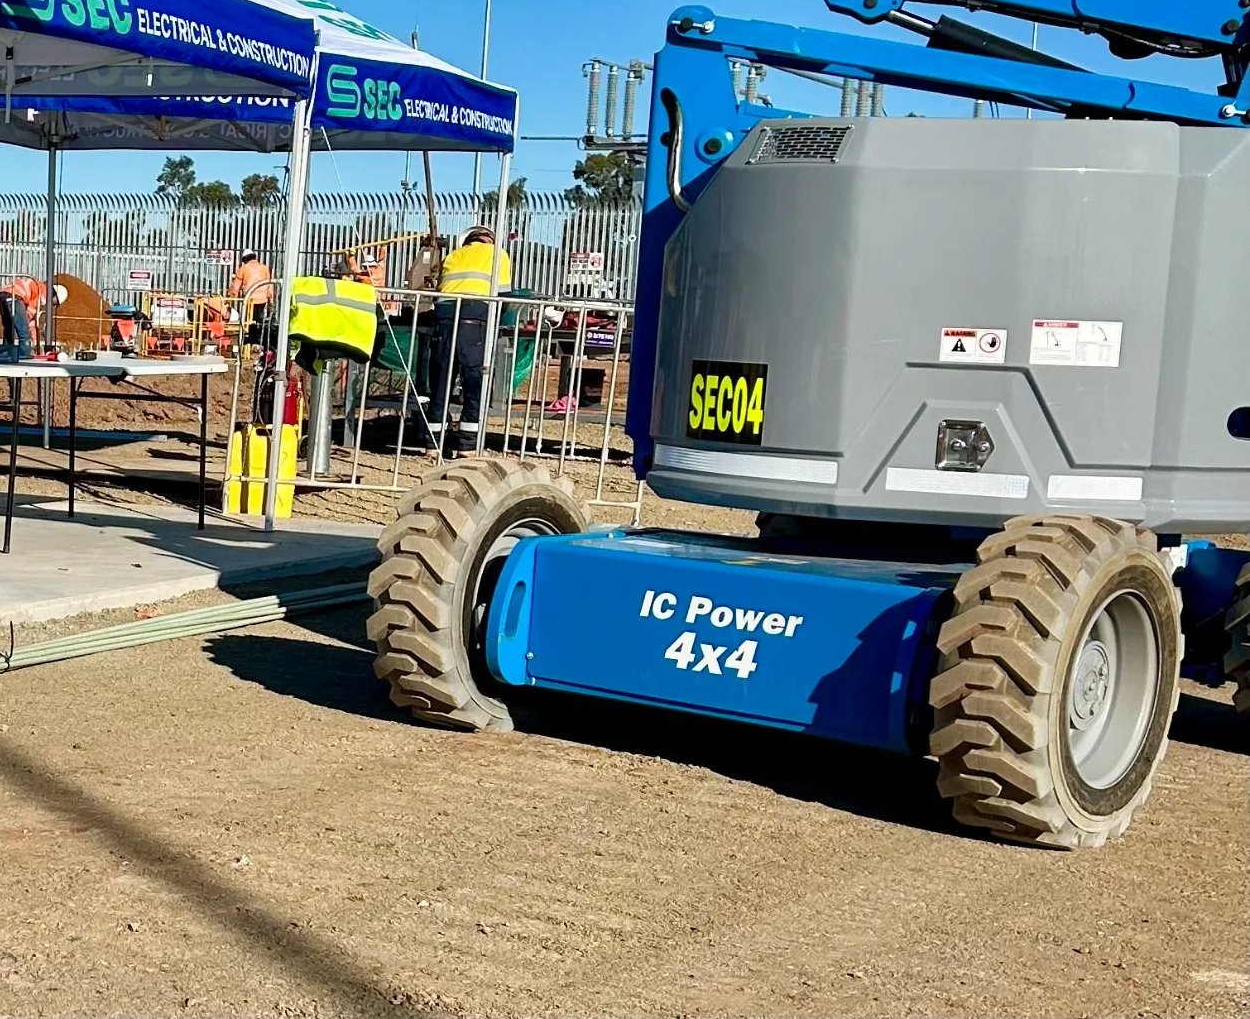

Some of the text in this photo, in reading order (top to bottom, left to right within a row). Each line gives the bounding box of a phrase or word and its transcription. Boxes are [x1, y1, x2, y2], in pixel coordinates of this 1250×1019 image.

[137, 7, 217, 50] ELECTRICAL
[216, 29, 228, 50] &
[226, 32, 310, 79] CONSTRUCTION
[363, 77, 513, 135] SEC ELECTRICAL & CONSTRUCTION
[689, 372, 764, 435] SEC04
[639, 589, 804, 637] IC Power
[664, 631, 759, 679] 4x4
